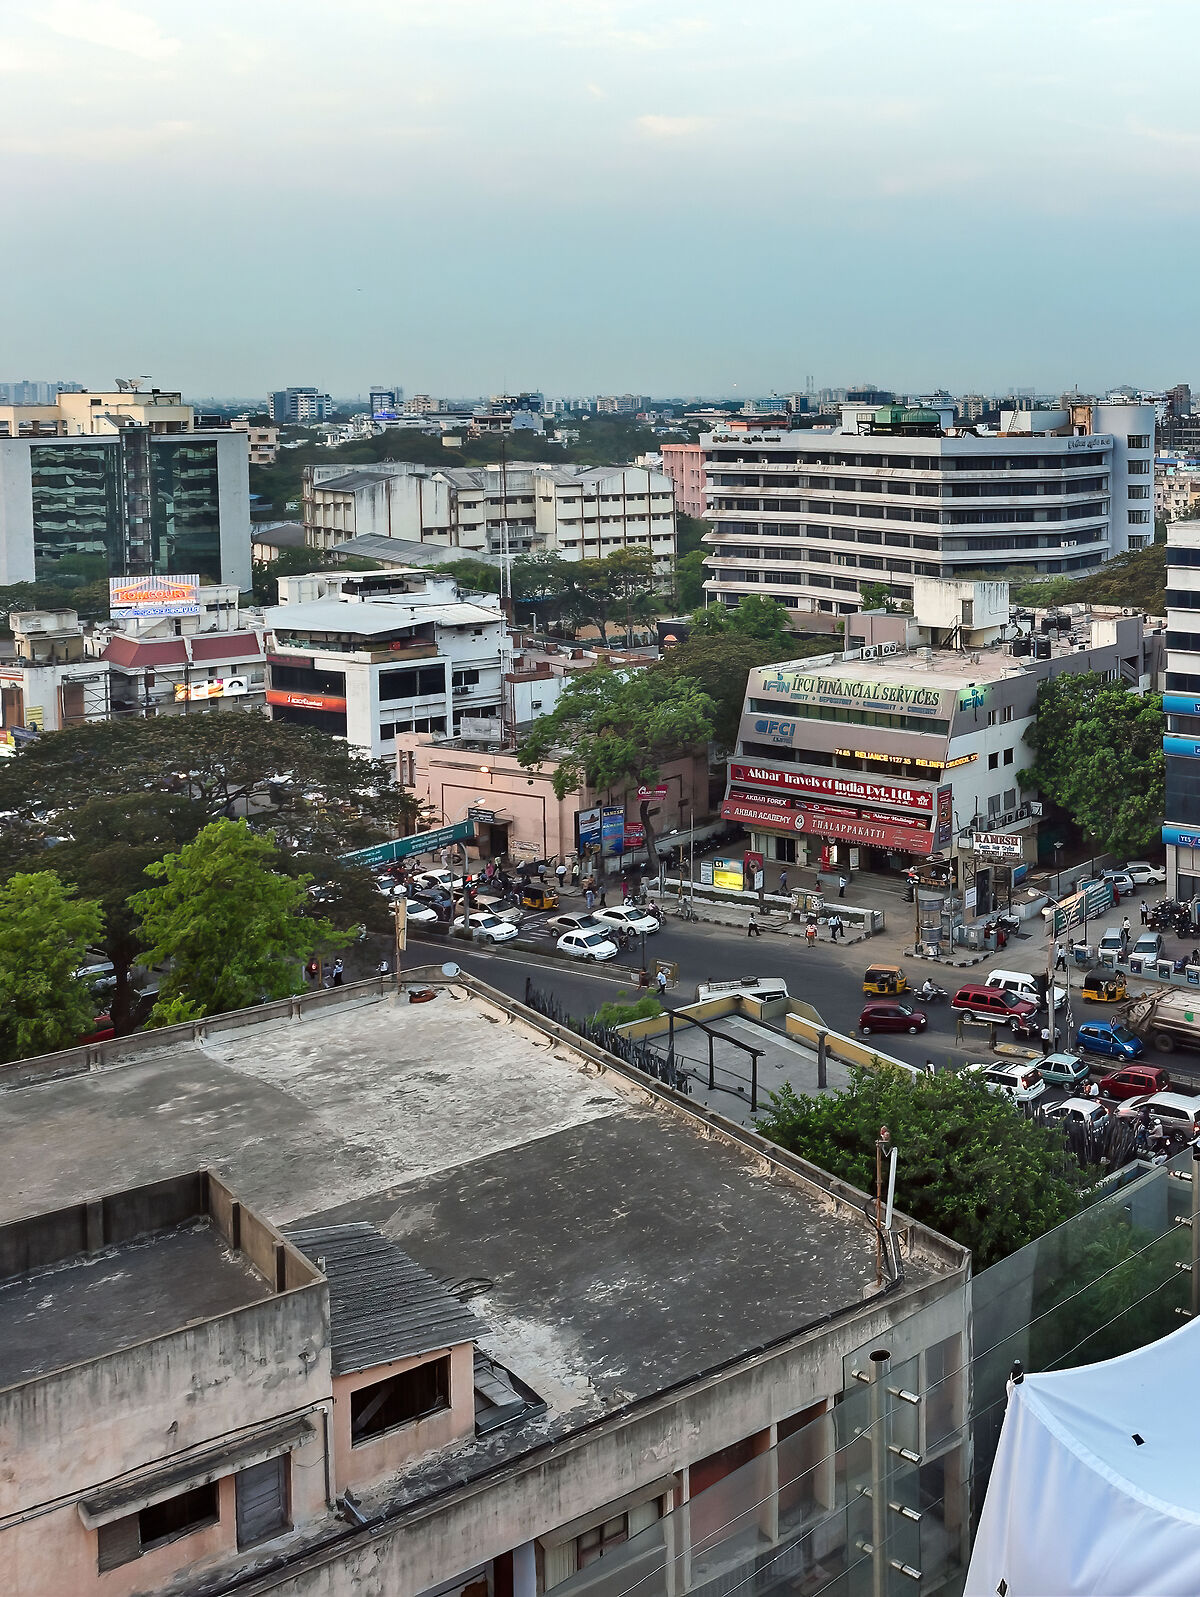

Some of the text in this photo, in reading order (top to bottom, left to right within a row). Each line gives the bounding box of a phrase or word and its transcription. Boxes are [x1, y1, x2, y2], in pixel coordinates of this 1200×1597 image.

[791, 677, 939, 706] IFCI FINANCIAL SERVICES
[854, 750, 889, 762] RELIANCE
[747, 768, 781, 782] Akbar
[783, 773, 821, 788] Travels
[822, 779, 833, 789] of
[834, 780, 865, 794] India
[866, 785, 889, 798] Pvt.
[891, 788, 914, 801] Ltd.
[767, 797, 787, 807] FOREX
[734, 807, 792, 824] AKBAR ACADEMY
[811, 819, 886, 839] THALAPPAKATTI
[974, 833, 1019, 846] RAMESH
[1180, 835, 1192, 843] YES
